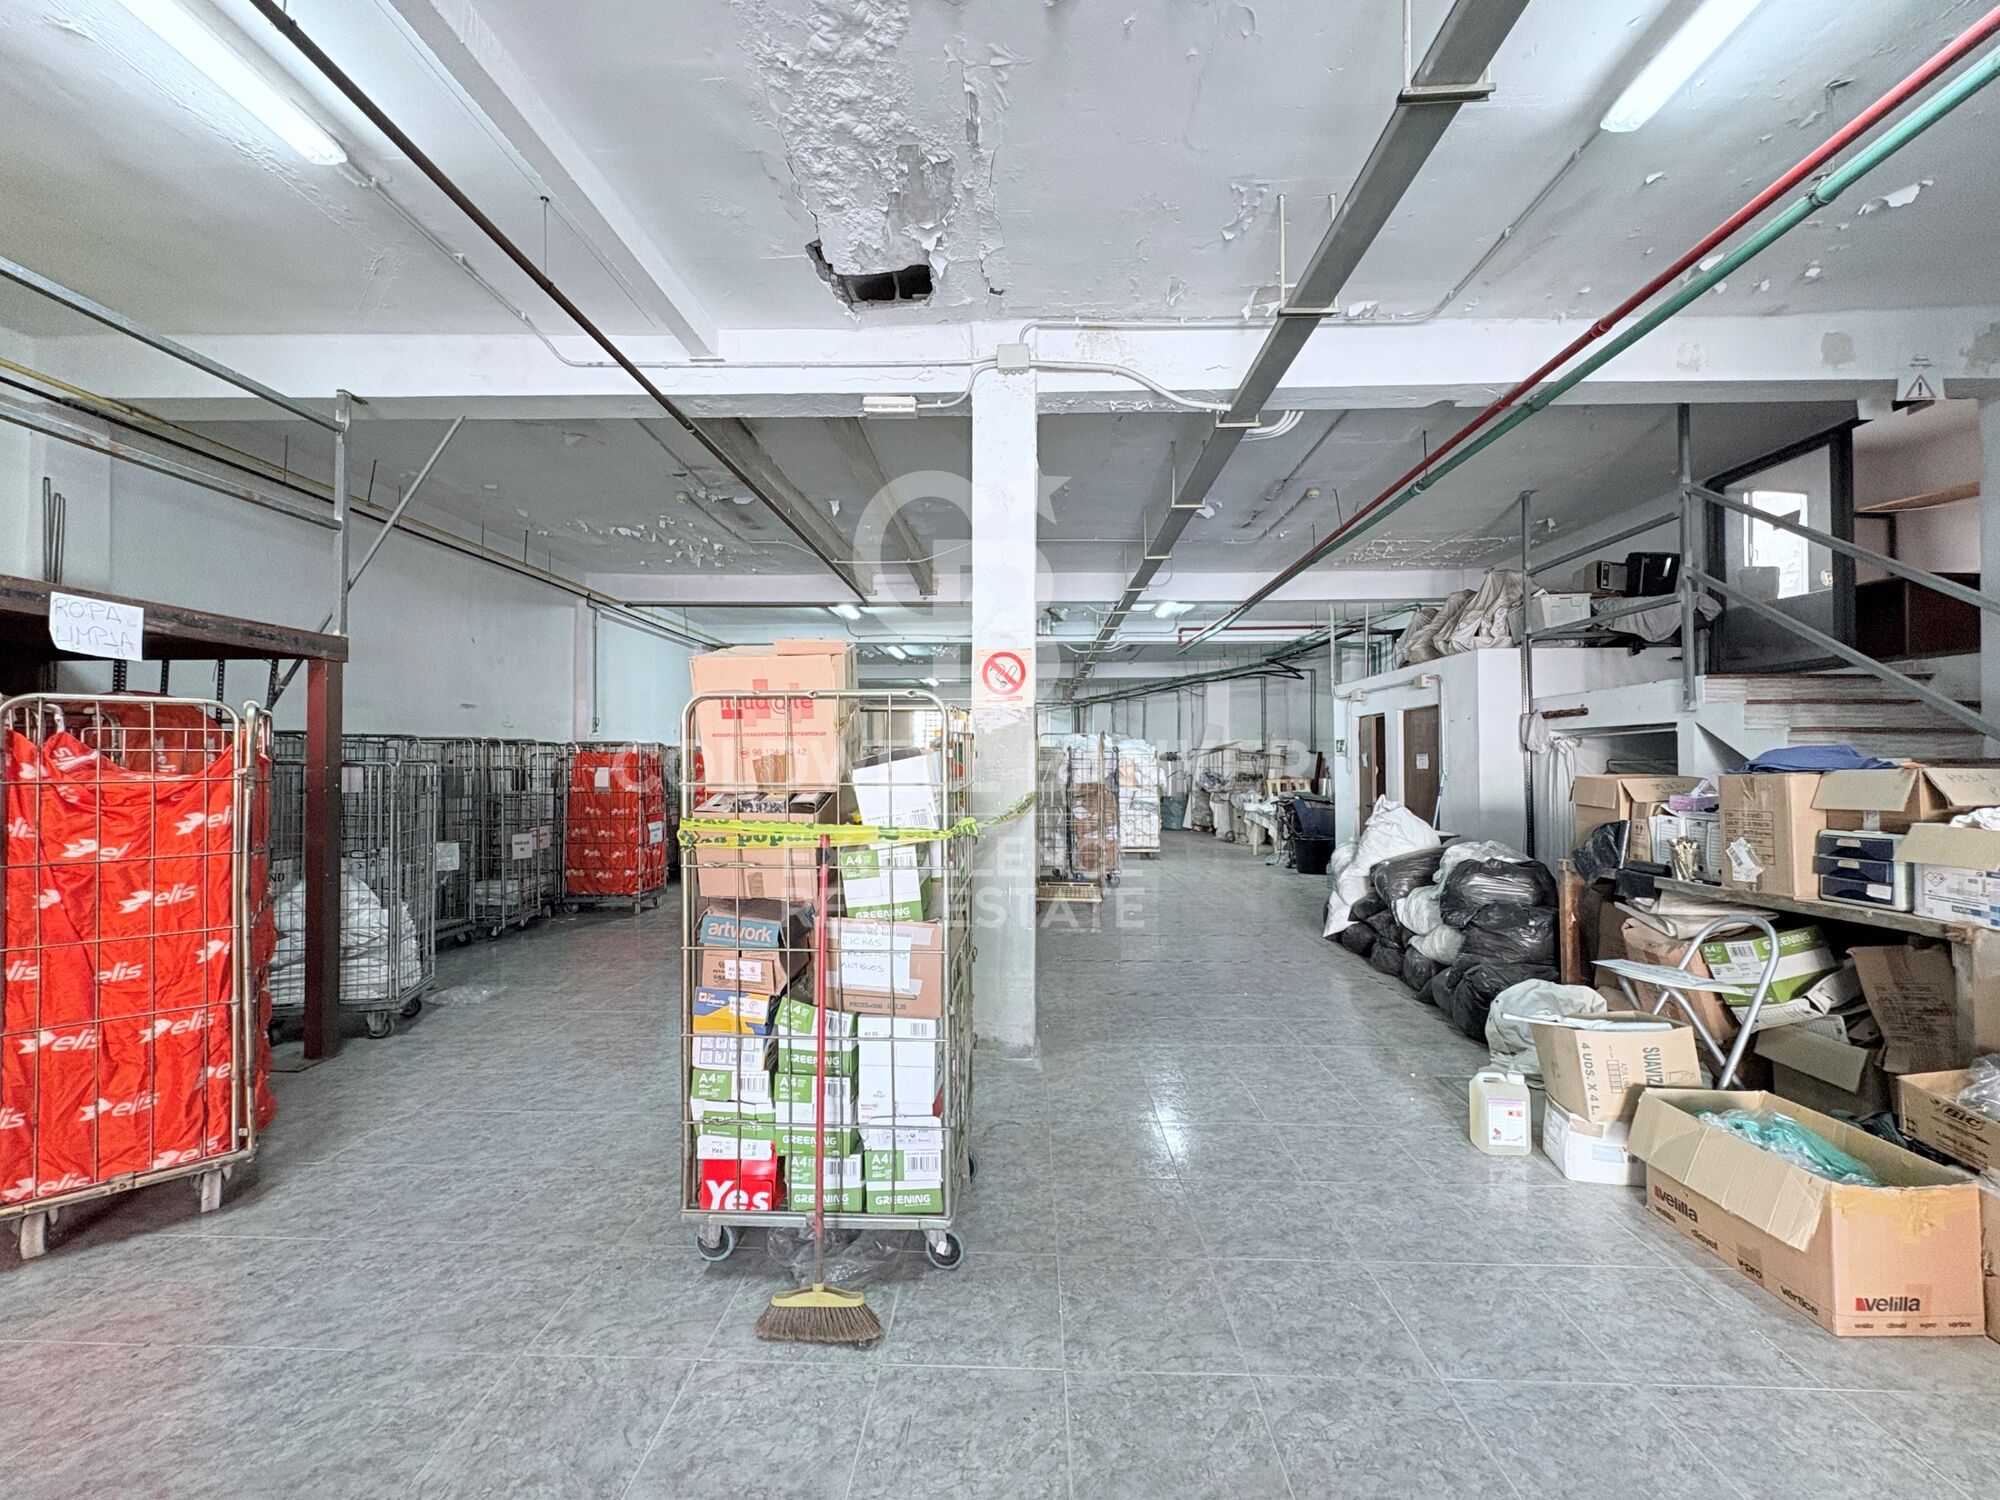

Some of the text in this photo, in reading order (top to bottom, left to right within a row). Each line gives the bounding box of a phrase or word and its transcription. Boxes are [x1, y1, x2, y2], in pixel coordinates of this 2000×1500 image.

[53, 597, 122, 625] ROPA
[154, 881, 199, 908] elis
[707, 920, 773, 943] artwork
[95, 961, 144, 984] elis
[170, 1009, 216, 1036] elis
[51, 1028, 102, 1053] elis
[1581, 1041, 1592, 1050] 4
[1582, 1053, 1595, 1079] UDS.
[698, 1072, 717, 1084] A4
[1587, 1082, 1597, 1091] X
[1589, 1094, 1600, 1103] 4
[871, 1153, 889, 1164] A4
[705, 1179, 771, 1211] Yes
[1660, 1188, 1699, 1224] velilla
[1865, 1296, 1921, 1312] velilla
